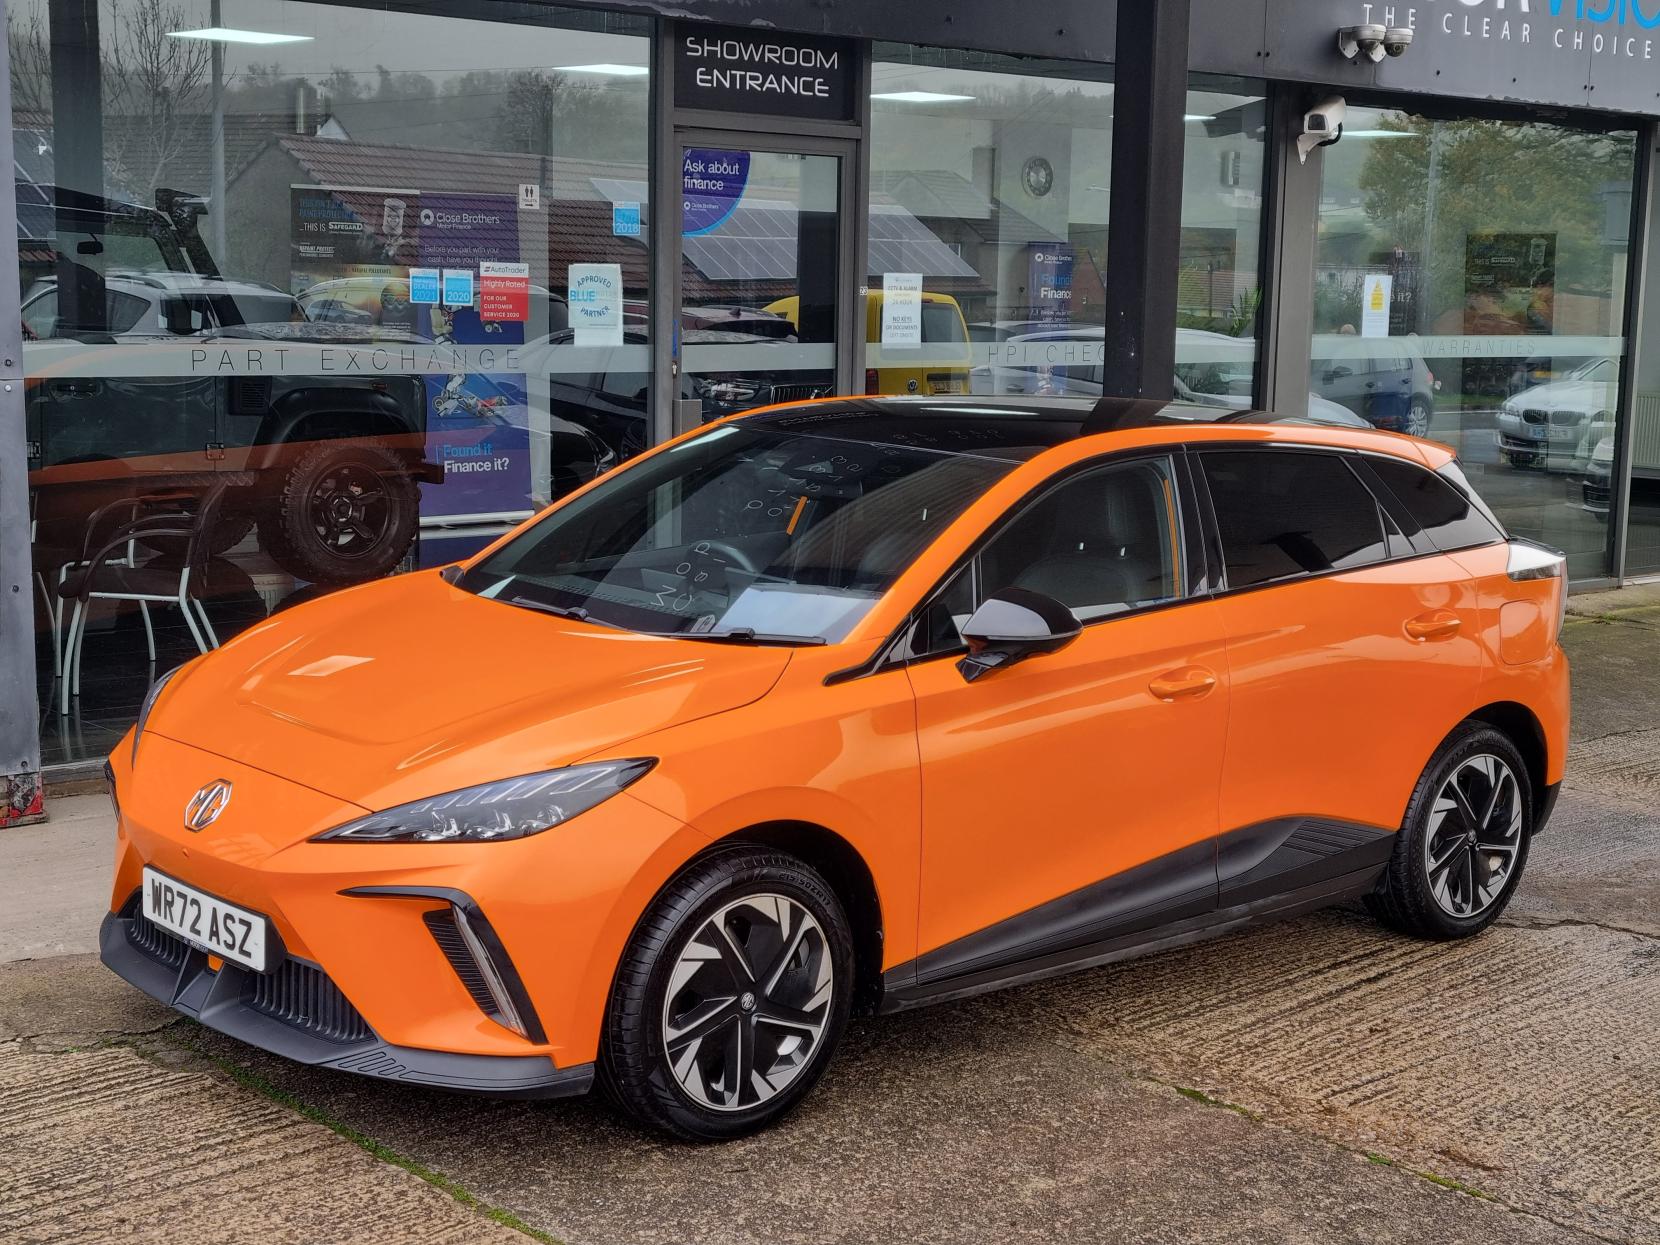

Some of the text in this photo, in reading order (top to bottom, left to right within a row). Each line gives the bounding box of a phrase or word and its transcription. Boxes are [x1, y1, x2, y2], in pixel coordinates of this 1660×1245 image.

[1363, 3, 1417, 29] THE
[1443, 13, 1531, 43] CLEAR
[1554, 28, 1652, 59] CHOICE
[686, 37, 838, 69] SHOWROOM
[696, 67, 830, 97] ENTRANCE
[684, 159, 739, 175] Ask about
[684, 175, 724, 190] finance
[436, 212, 500, 224] Close Brothers
[319, 222, 326, 231] IS
[616, 223, 639, 233] 2018
[424, 245, 446, 253] Before
[491, 266, 525, 274] AutoTrader
[483, 280, 505, 289] Highly
[577, 275, 612, 288] APPROVED
[447, 291, 470, 302] 2020
[569, 290, 595, 302] BLUE
[580, 305, 610, 318] PARTNER
[988, 345, 1104, 362] HPI CHEC
[1422, 339, 1536, 355] WARRANTIES
[191, 349, 520, 371] PART EXCHANGE
[443, 443, 493, 457] Found it
[444, 457, 510, 473] Finance it?
[186, 780, 231, 830] MG
[151, 878, 252, 959] WR72 ASZ
